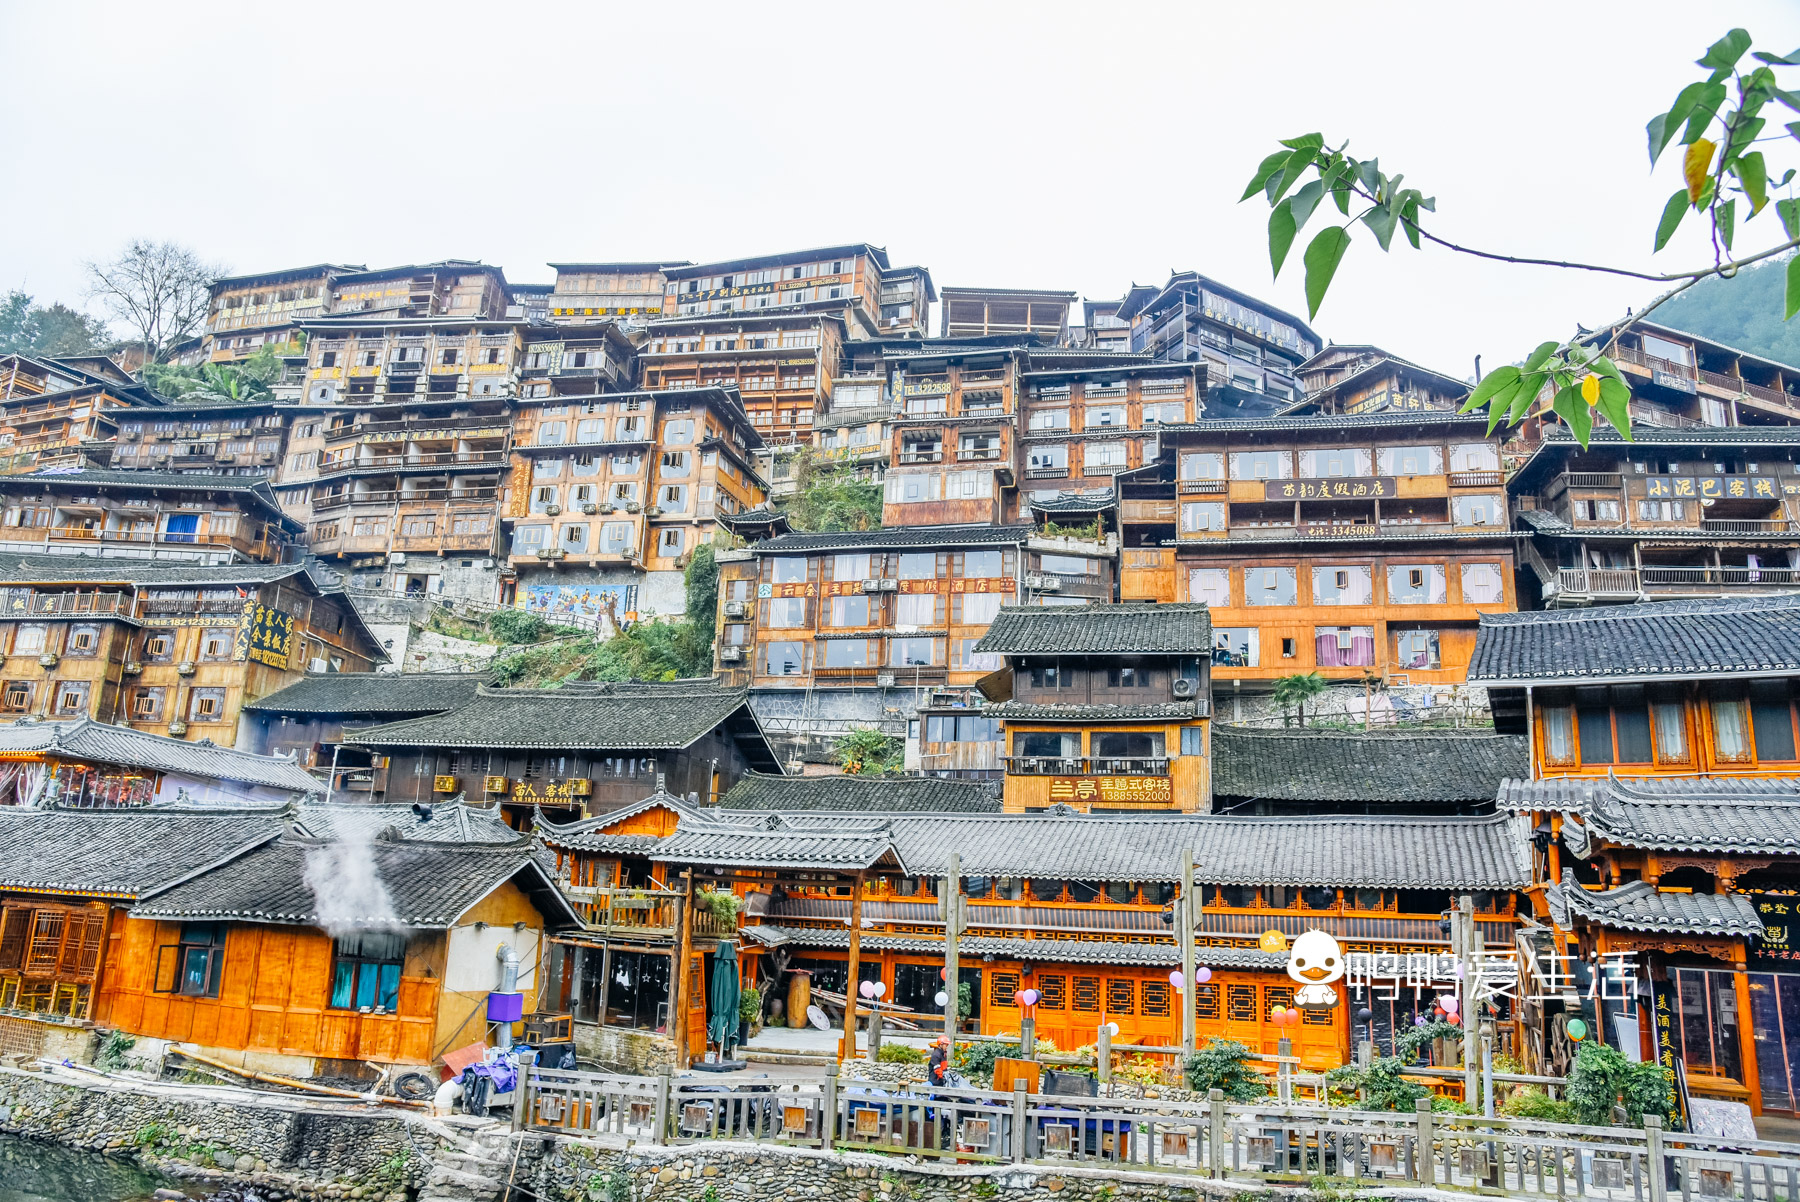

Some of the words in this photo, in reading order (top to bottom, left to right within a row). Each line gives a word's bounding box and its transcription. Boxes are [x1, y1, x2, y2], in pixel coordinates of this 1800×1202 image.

[1282, 480, 1385, 498] 苗韵度假酒店
[1649, 478, 1776, 498] 小泥巴客栈
[1050, 779, 1098, 799] 兰亭
[1101, 791, 1170, 801] 13885552000
